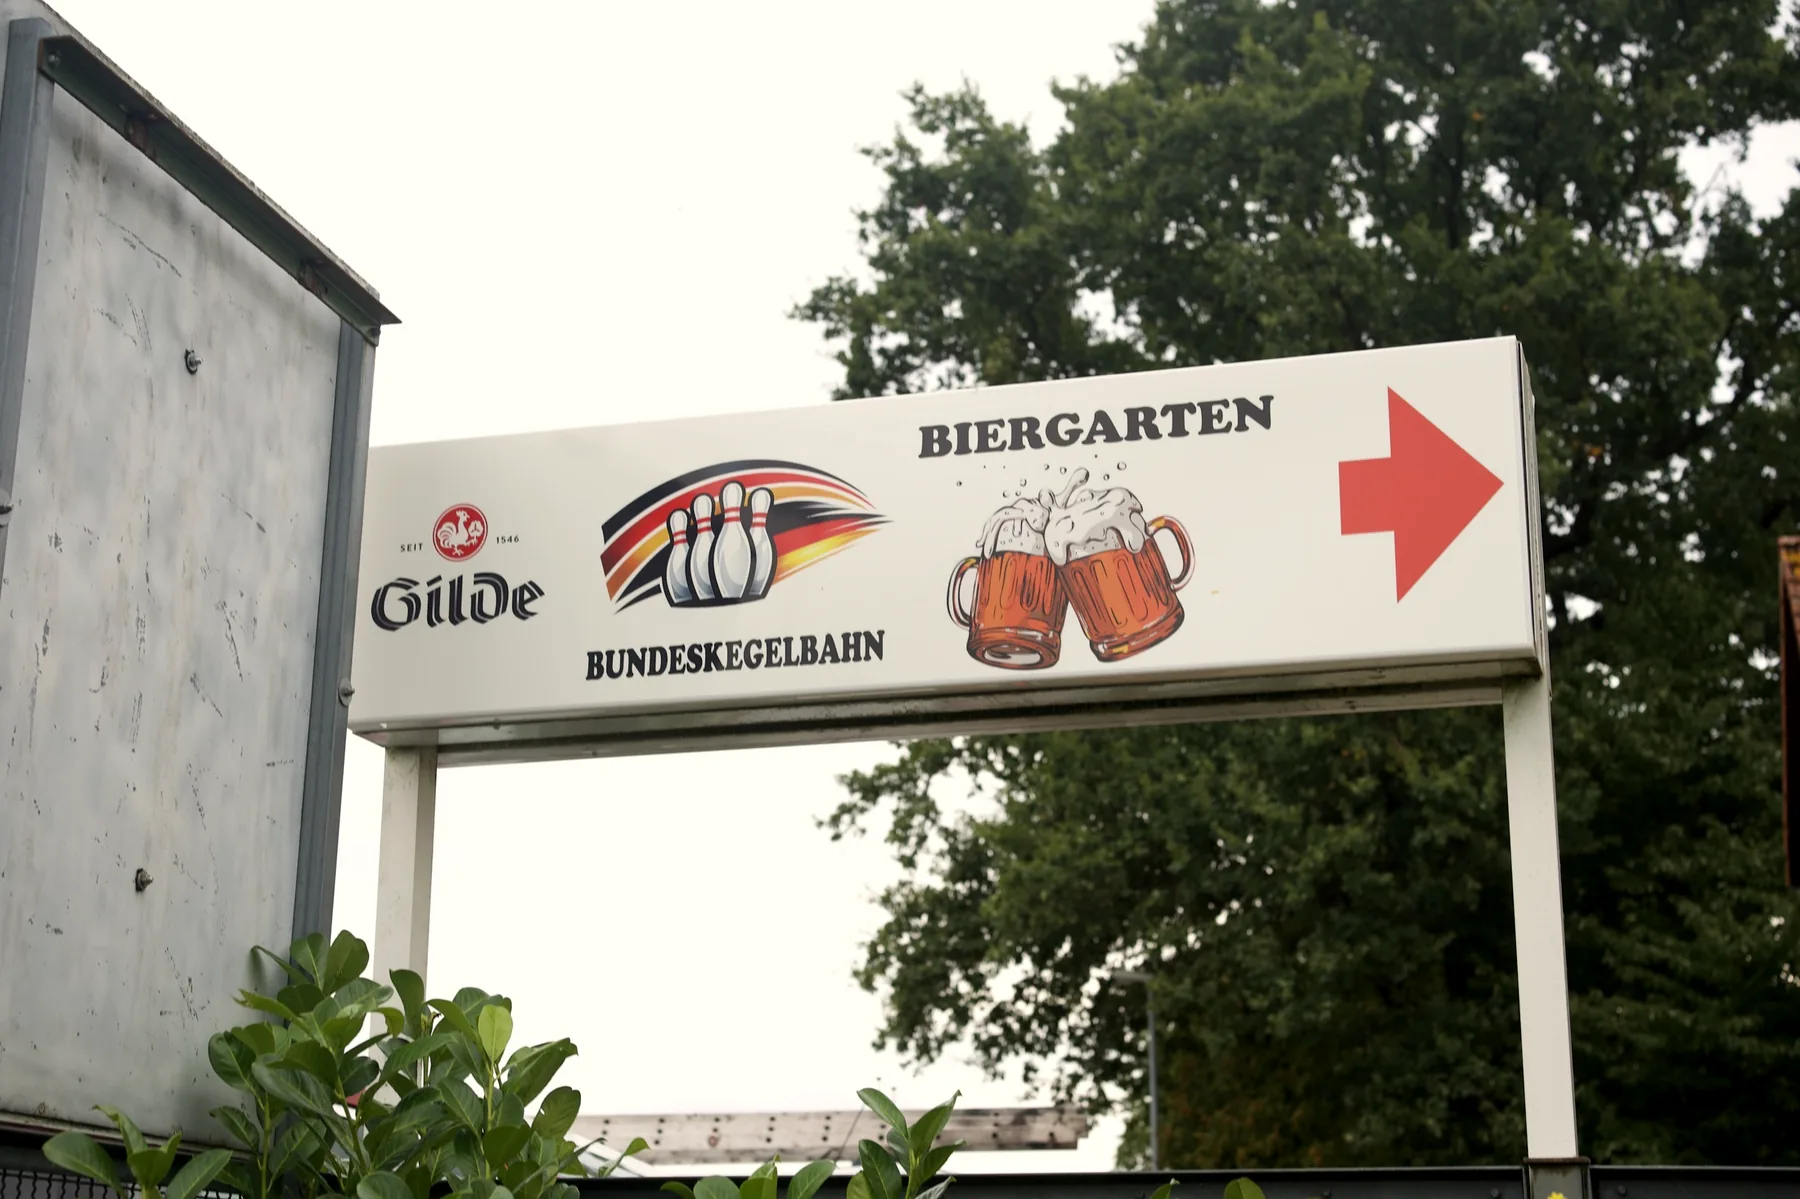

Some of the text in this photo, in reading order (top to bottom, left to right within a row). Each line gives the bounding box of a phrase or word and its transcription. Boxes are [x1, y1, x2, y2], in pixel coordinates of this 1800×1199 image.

[918, 395, 1275, 459] BIERGARTEN
[399, 534, 520, 553] SEIT 1546
[585, 629, 885, 681] BUNDESKEGELBAHN
